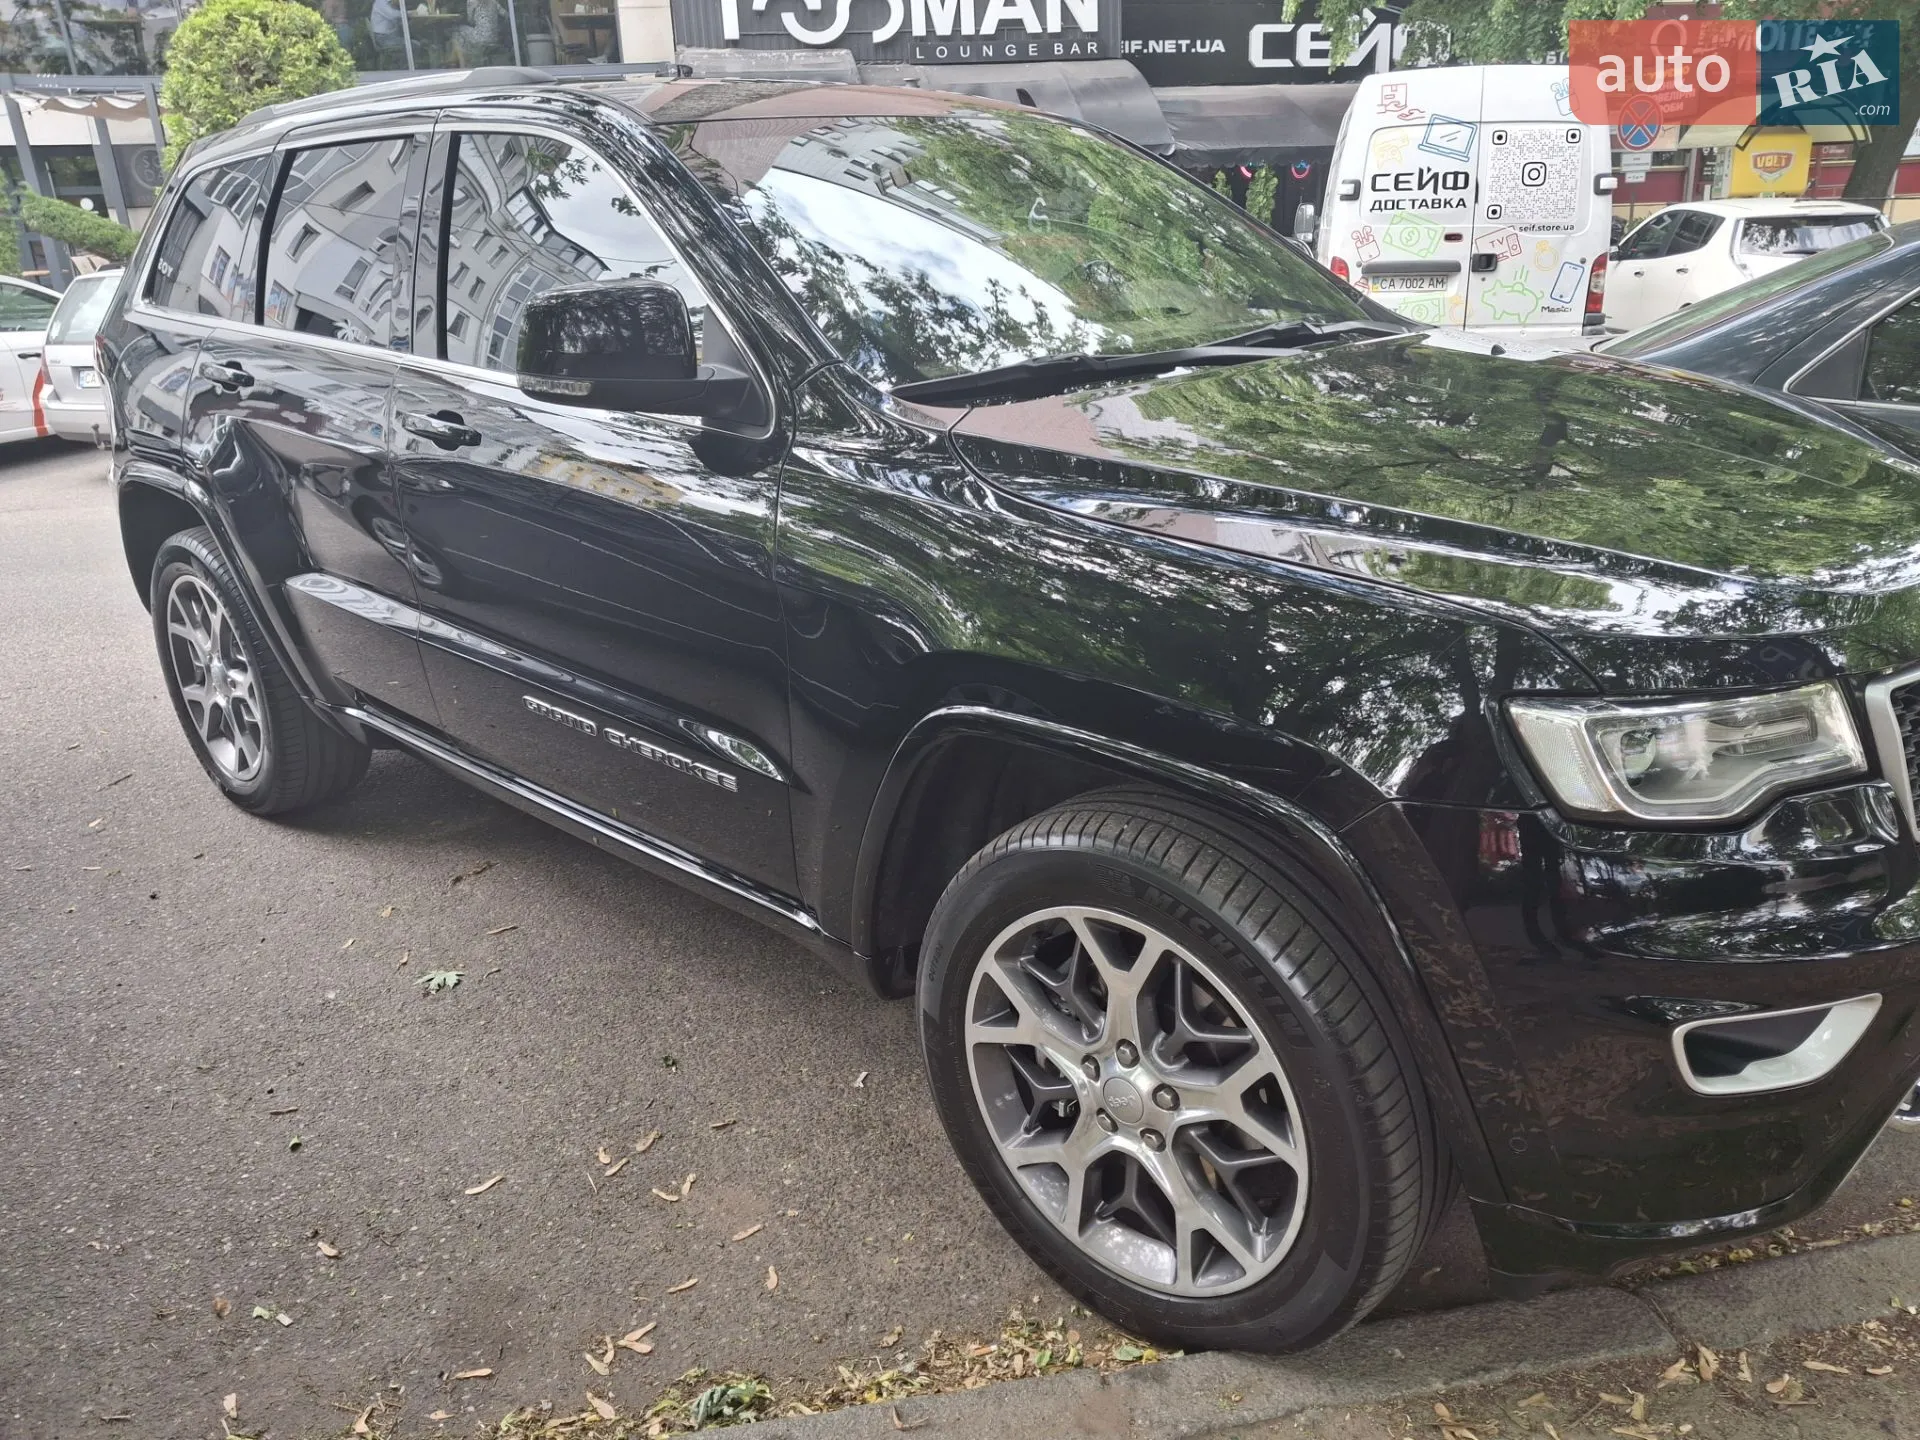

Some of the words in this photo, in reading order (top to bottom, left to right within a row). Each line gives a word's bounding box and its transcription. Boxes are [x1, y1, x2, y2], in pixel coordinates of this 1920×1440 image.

[916, 43, 1038, 59] LOUNGE
[1054, 41, 1098, 55] BAR
[1371, 166, 1470, 195] СЕЙФ
[1369, 197, 1467, 213] ДОСТАВКА
[1519, 223, 1575, 232] seif.store.ua
[1489, 236, 1504, 248] TV
[1380, 277, 1396, 290] CA
[1399, 278, 1425, 289] 7002
[1428, 277, 1445, 289] AM
[522, 695, 597, 736] GRAND
[603, 728, 738, 793] CHEROKEE
